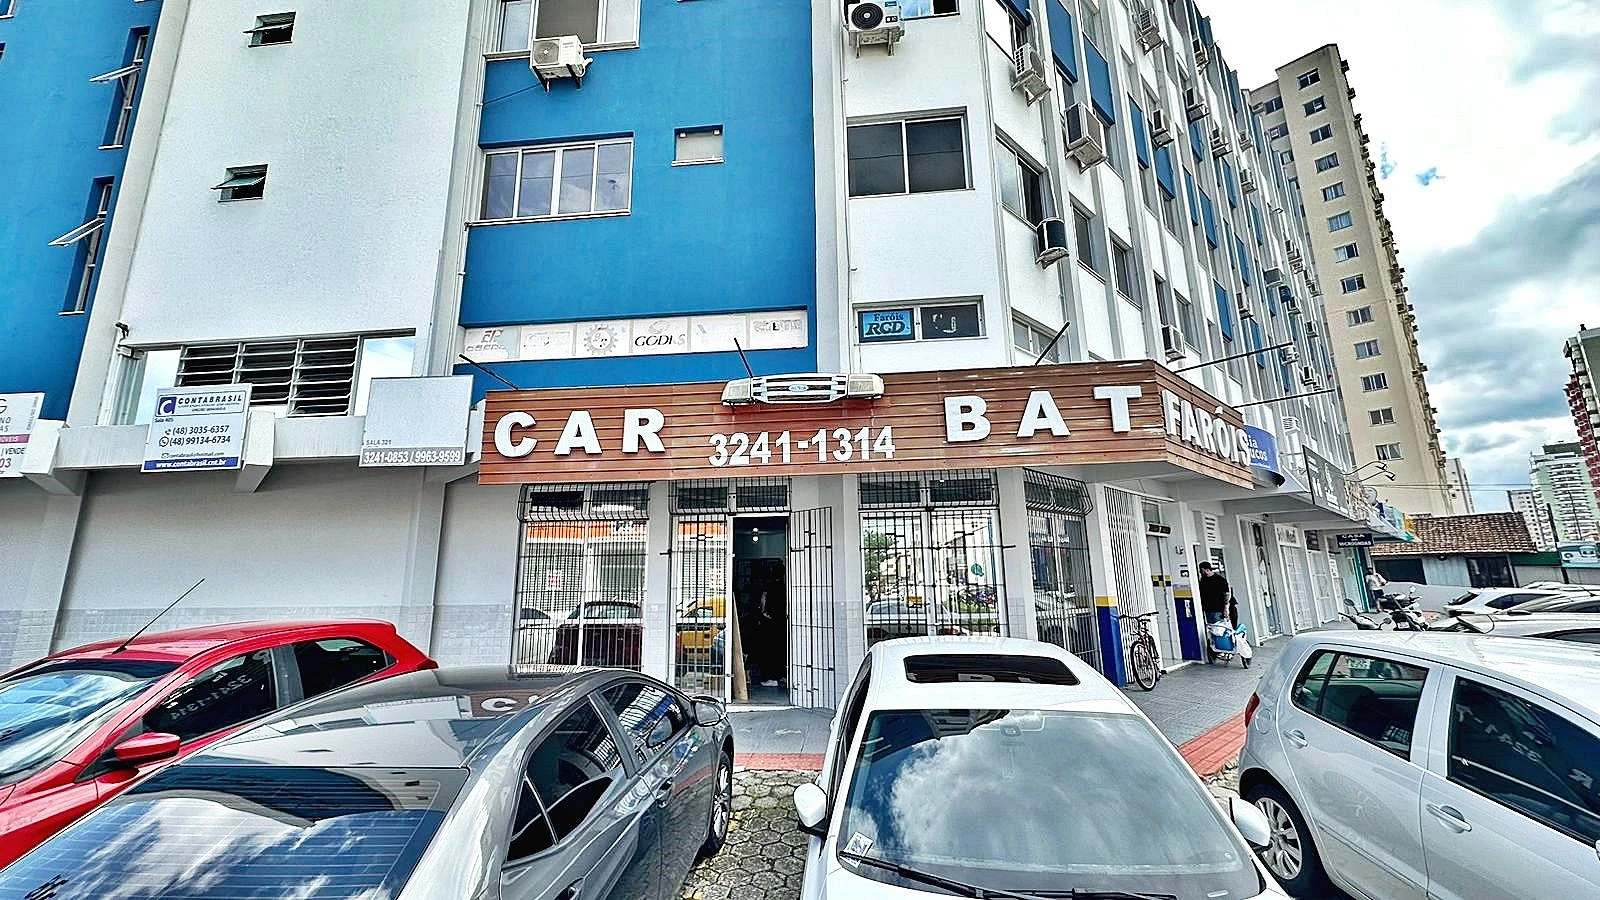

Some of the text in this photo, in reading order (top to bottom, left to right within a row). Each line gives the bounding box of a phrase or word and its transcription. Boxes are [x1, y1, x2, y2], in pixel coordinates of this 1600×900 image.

[178, 394, 243, 405] CONTABRASIL
[494, 384, 1144, 458] CAR BAT
[1161, 388, 1252, 468] FARÓIS
[172, 425, 230, 436] (48) 3035-6357
[169, 435, 231, 446] (48) 99134-6734
[708, 425, 896, 469] 3241-1314
[363, 451, 409, 464] 3241-0853
[415, 450, 461, 463] 9963-9599
